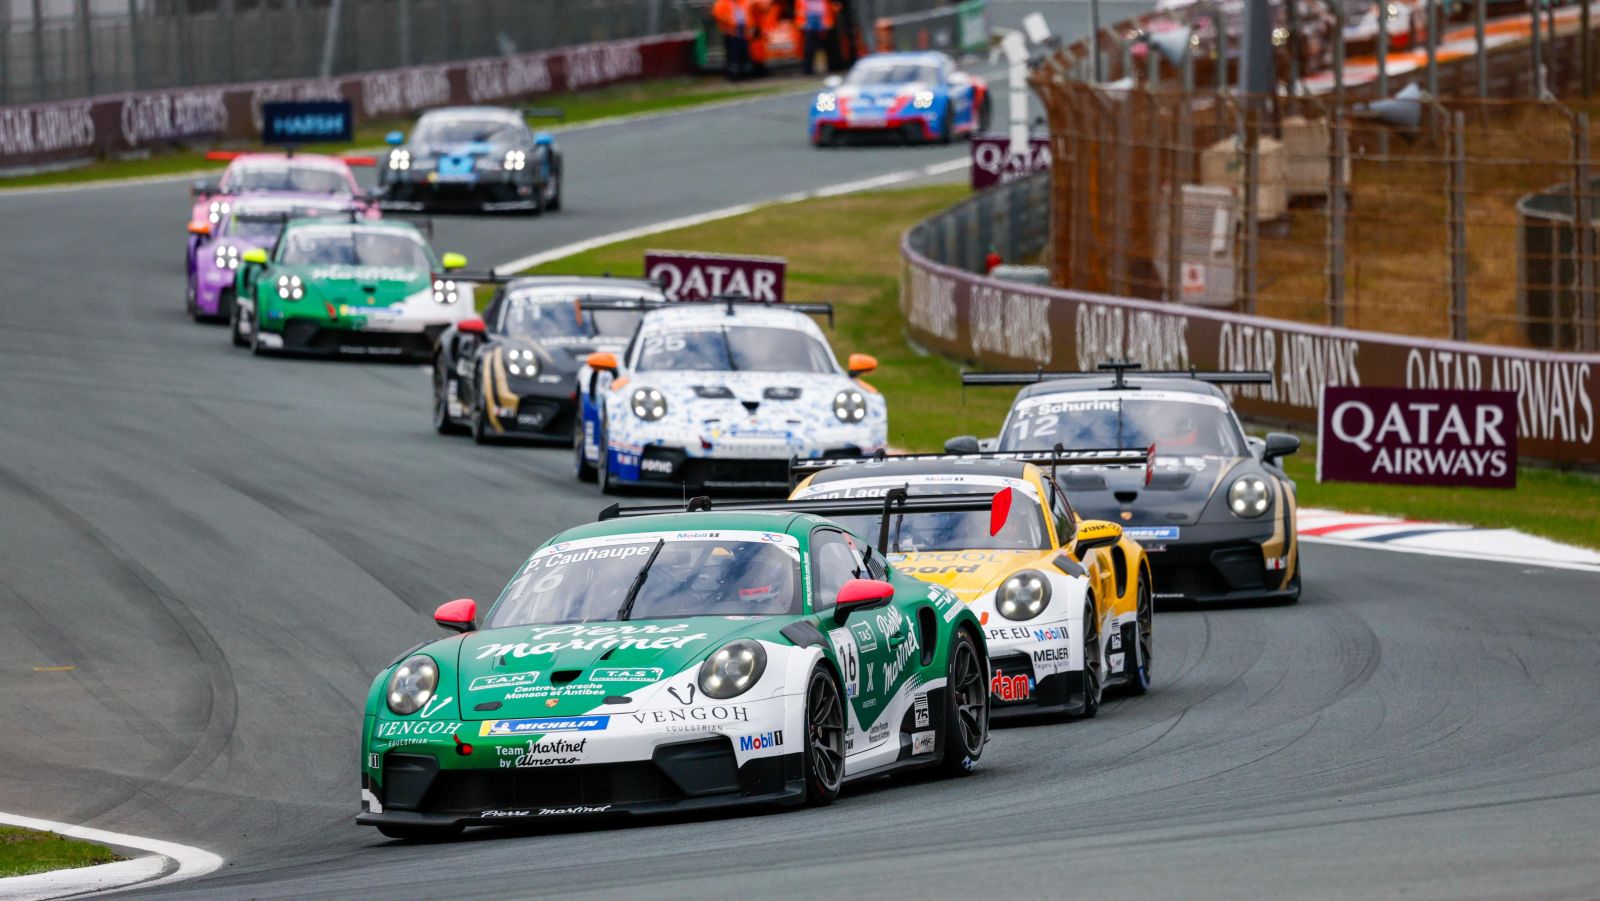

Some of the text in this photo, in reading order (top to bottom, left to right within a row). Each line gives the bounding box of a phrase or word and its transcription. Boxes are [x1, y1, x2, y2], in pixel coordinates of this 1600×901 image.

[976, 142, 1052, 175] QATA
[650, 263, 777, 302] QATAR
[644, 332, 686, 356] 25
[1219, 322, 1360, 408] QATAR AIRWAYS
[1017, 401, 1120, 419] F. Schuring
[1013, 415, 1060, 441] 12
[1331, 400, 1506, 453] QATAR
[1372, 447, 1507, 477] AIRWAYS
[845, 487, 891, 499] Lage
[1080, 524, 1108, 533] VINK
[523, 558, 541, 574] P.
[545, 546, 651, 568] Cauhaupe
[901, 564, 981, 574] oord
[508, 566, 565, 601] 16
[530, 623, 690, 641] Pierre
[1033, 627, 1062, 641] Mobil
[476, 632, 708, 659] Martinet
[839, 643, 857, 683] 16
[1034, 648, 1069, 662] MEIJER
[484, 675, 526, 685] T.A.N
[991, 669, 1030, 701] dam
[504, 692, 548, 700] Monaco
[632, 706, 749, 725] VENGOH
[915, 708, 928, 720] 75
[377, 720, 463, 738] VENGOH
[516, 720, 599, 730] MICHELIN
[388, 738, 428, 748] EQUESTRIAN
[495, 738, 587, 756] Team Martinet
[740, 732, 774, 752] Mobil
[499, 759, 511, 768] by
